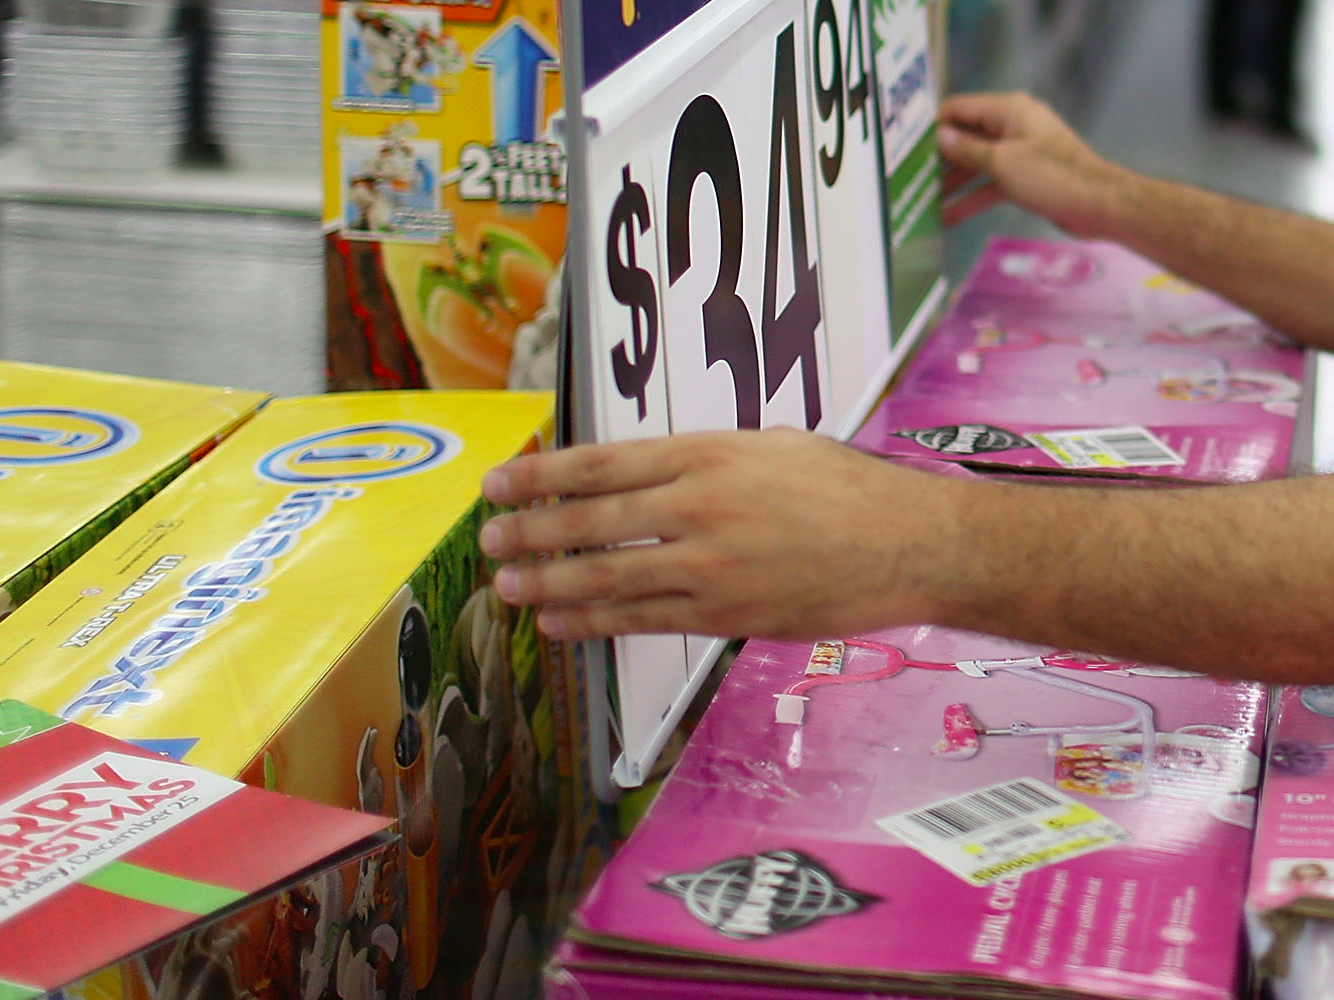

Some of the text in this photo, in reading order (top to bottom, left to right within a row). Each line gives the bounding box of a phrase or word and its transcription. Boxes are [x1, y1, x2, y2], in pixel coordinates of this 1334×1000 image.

[62, 486, 365, 720] imaginext
[115, 554, 187, 602] ULTRA
[58, 600, 135, 649] T-REX
[0, 762, 142, 858] RRY
[0, 778, 196, 888] RISTMAS
[67, 808, 174, 866] December
[169, 795, 199, 811] 25
